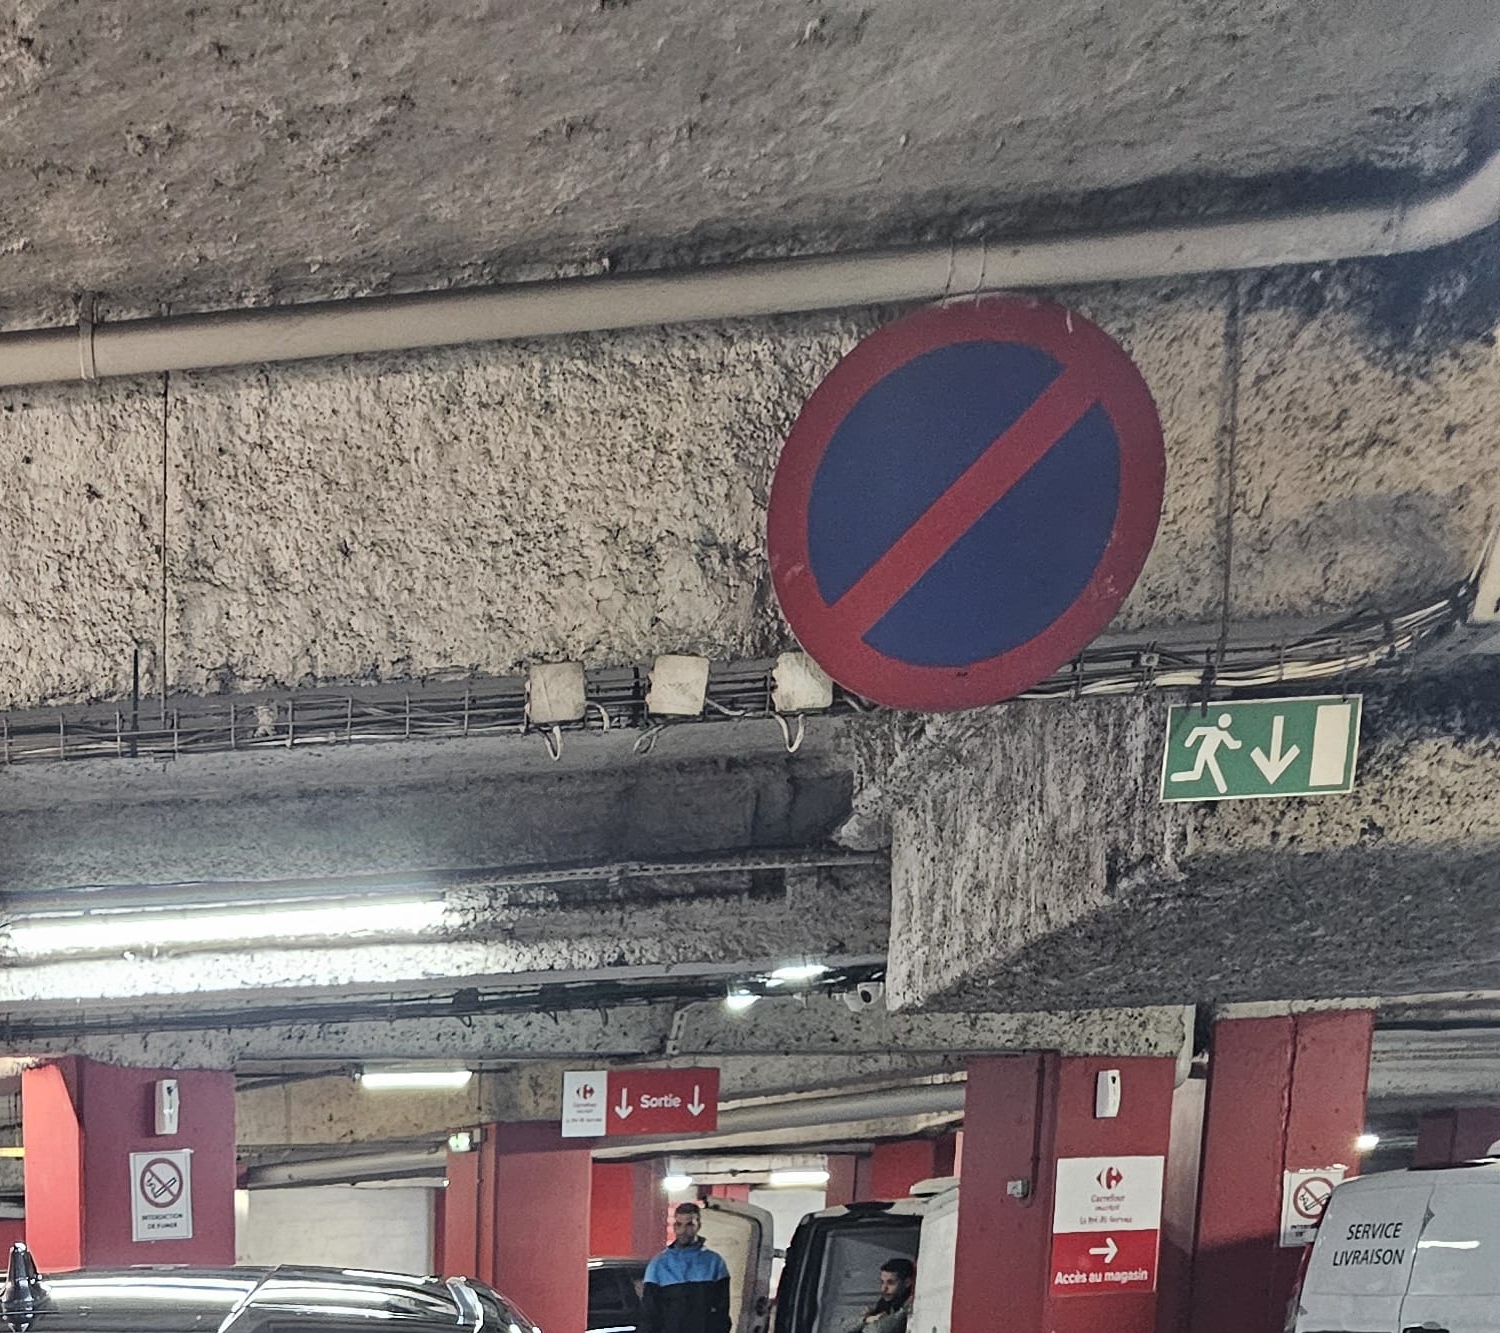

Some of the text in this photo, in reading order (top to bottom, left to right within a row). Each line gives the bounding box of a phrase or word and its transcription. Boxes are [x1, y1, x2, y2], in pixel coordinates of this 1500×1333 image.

[640, 1093, 681, 1108] Sortie
[1346, 1222, 1403, 1241] SERVICE
[1332, 1248, 1405, 1267] LIVRAISON
[1054, 1267, 1148, 1285] Accès au magasin
